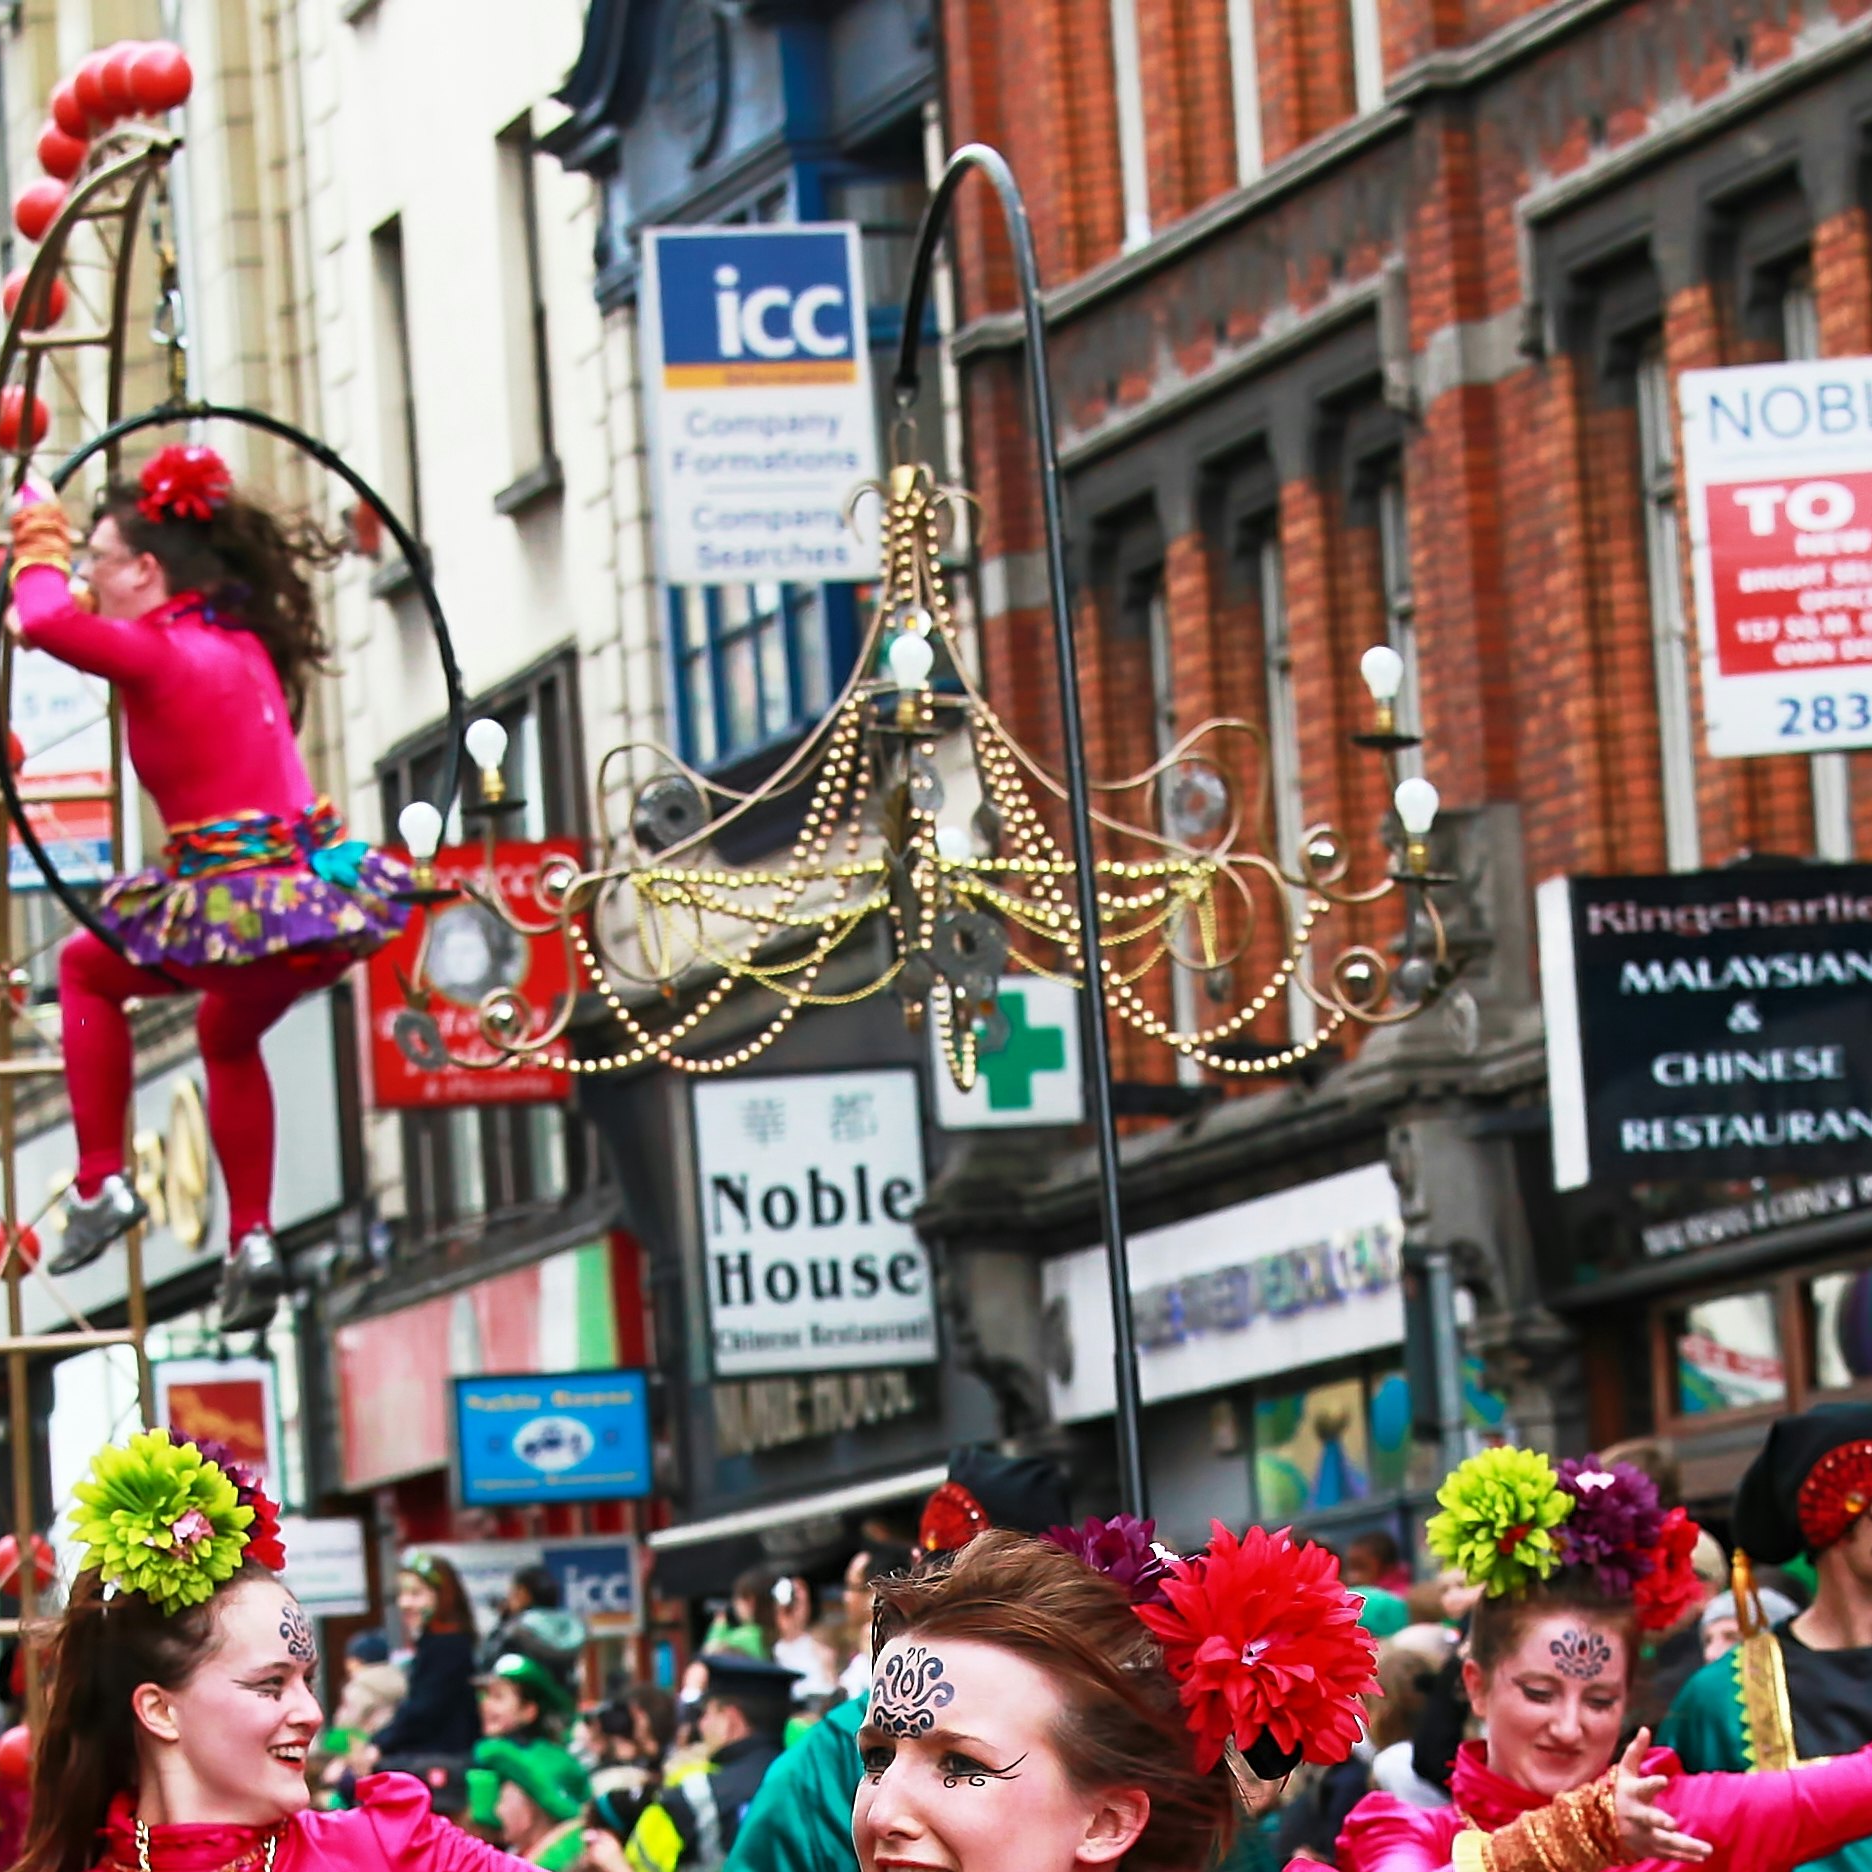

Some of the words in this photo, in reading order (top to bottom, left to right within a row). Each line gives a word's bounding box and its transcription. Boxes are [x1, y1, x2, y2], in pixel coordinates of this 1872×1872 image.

[714, 263, 849, 359] icc
[685, 408, 842, 441] Company
[673, 448, 859, 473] Formations
[691, 505, 846, 534] Company
[1732, 481, 1856, 537] TO
[696, 543, 851, 571] Searches
[1794, 529, 1872, 557] NEW
[1776, 692, 1872, 737] 283
[1726, 998, 1763, 1034] &
[1650, 1043, 1846, 1088] CHINESE
[711, 1163, 916, 1236] Noble
[715, 1250, 924, 1308] House
[715, 1327, 803, 1350] Chinese
[809, 1316, 930, 1345] Restaurant
[564, 1567, 630, 1610] icc
